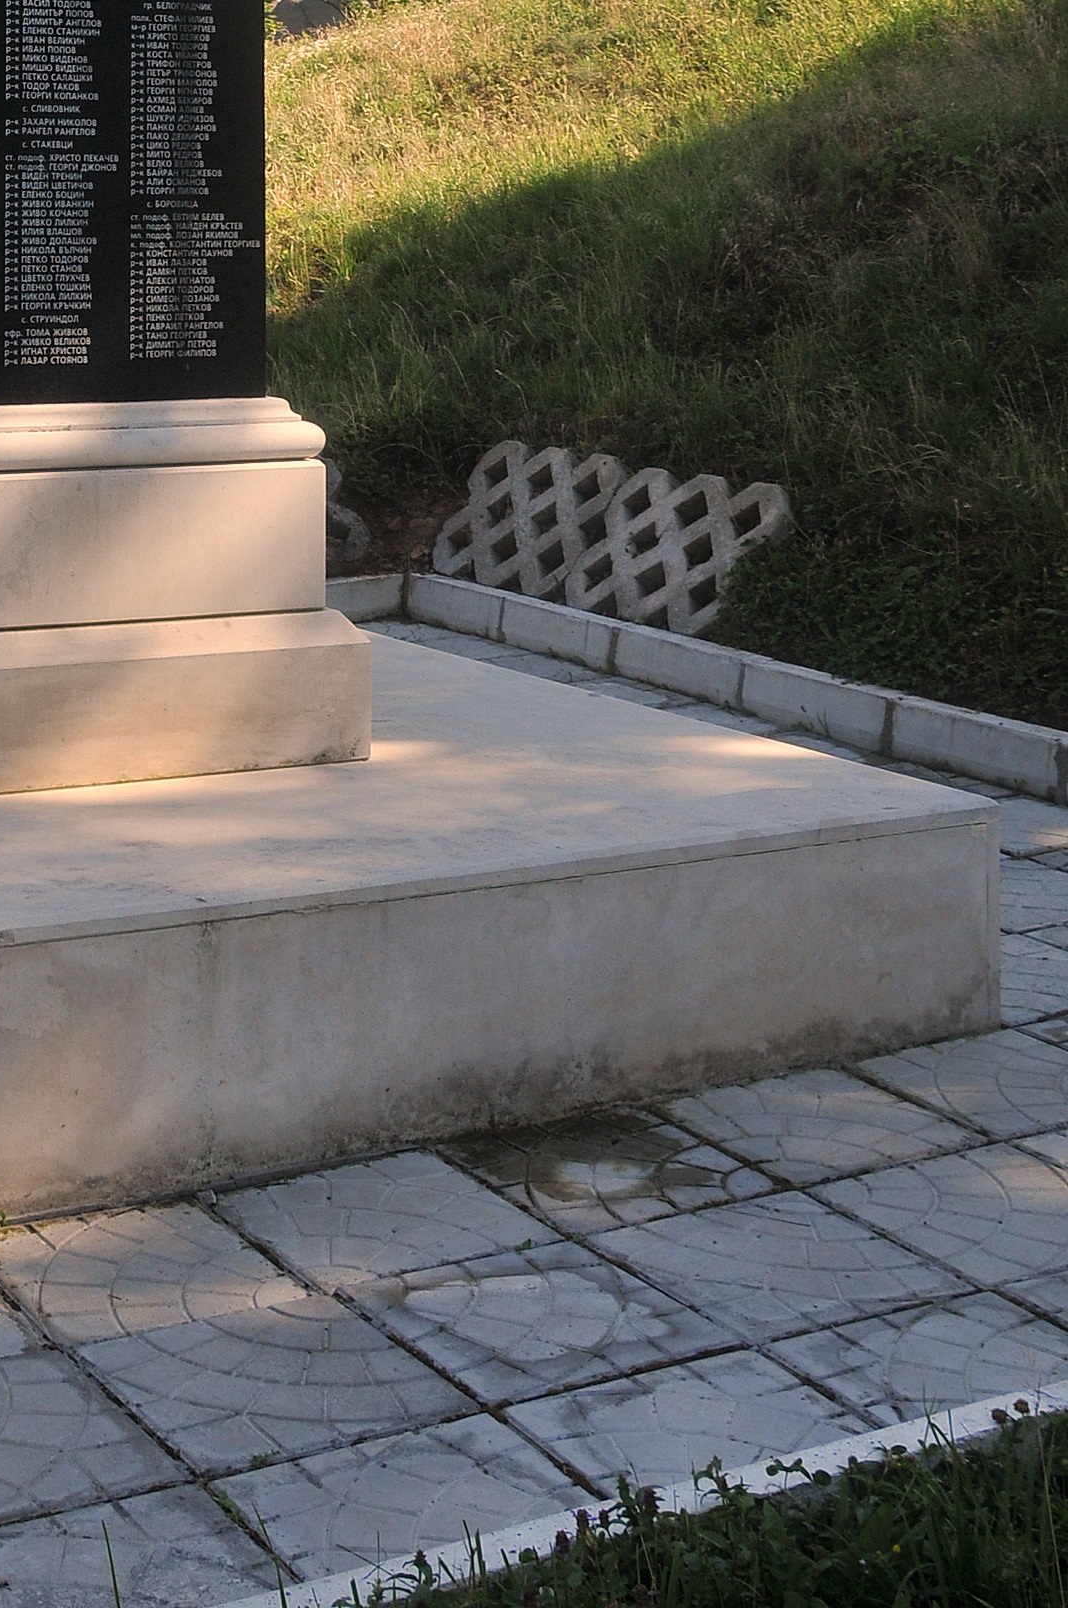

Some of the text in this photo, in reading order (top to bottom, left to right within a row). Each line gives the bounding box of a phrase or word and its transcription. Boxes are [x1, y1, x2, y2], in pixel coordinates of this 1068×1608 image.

[5, 0, 20, 7] р-к
[5, 18, 19, 26] р-к
[5, 45, 19, 53] р-к
[5, 73, 19, 81] р-к
[5, 118, 18, 127] р-к
[4, 210, 18, 219] р-к
[4, 257, 18, 265] р-к
[4, 285, 18, 293] р-к
[4, 349, 18, 357] р-к
